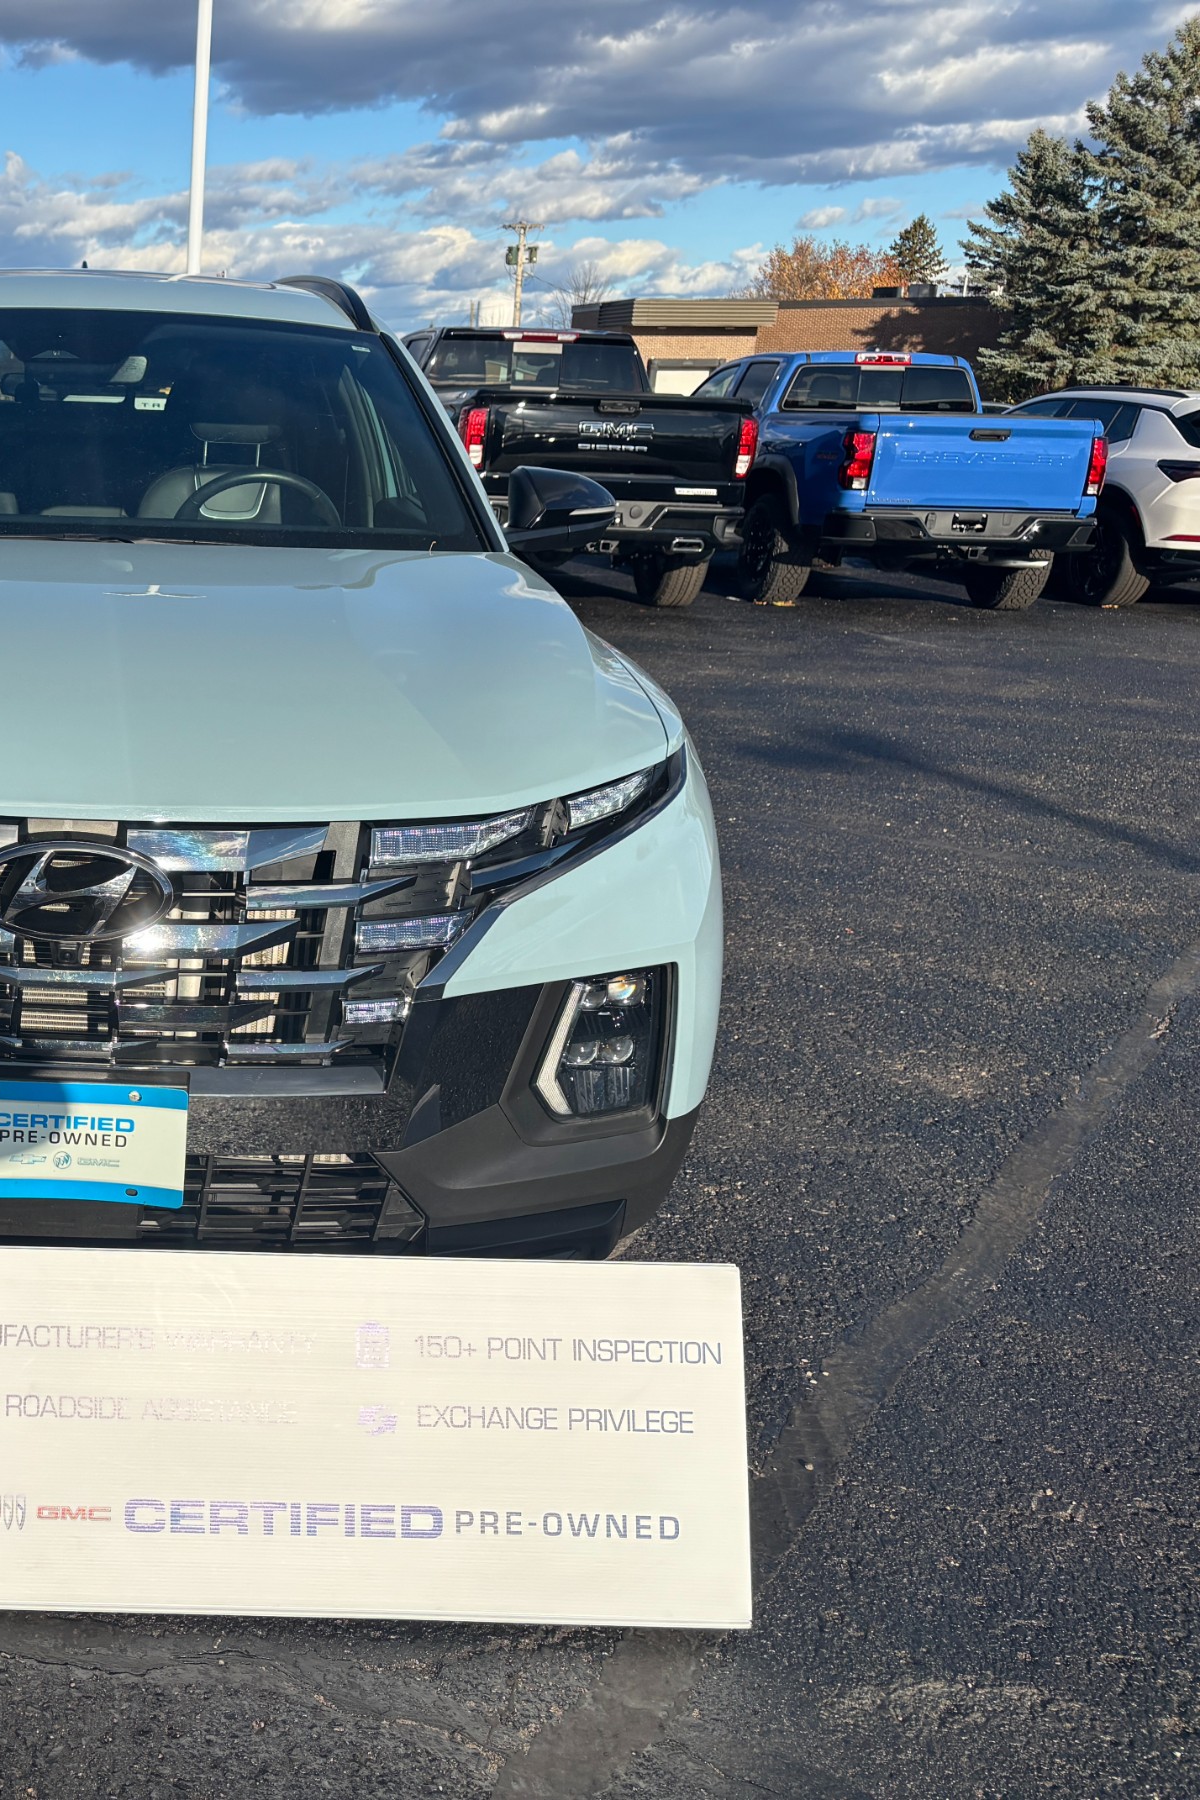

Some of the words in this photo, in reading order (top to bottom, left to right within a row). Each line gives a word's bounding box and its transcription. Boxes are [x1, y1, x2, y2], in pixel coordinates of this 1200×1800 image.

[579, 421, 654, 440] GMC
[578, 443, 648, 452] SIERRA
[0, 1129, 128, 1148] PRE-OWNED
[77, 1157, 120, 1168] GMC
[415, 1335, 477, 1359] 150+
[487, 1337, 562, 1361] POINT
[572, 1339, 722, 1364] INSPECTION
[5, 1394, 131, 1420] ROADSIDE
[417, 1405, 558, 1431] EXCHANGE
[568, 1408, 694, 1433] PRIVILEGE
[37, 1505, 112, 1521] GMC
[124, 1499, 443, 1539] CERTIFIED
[456, 1510, 680, 1540] PRE-OWNED
